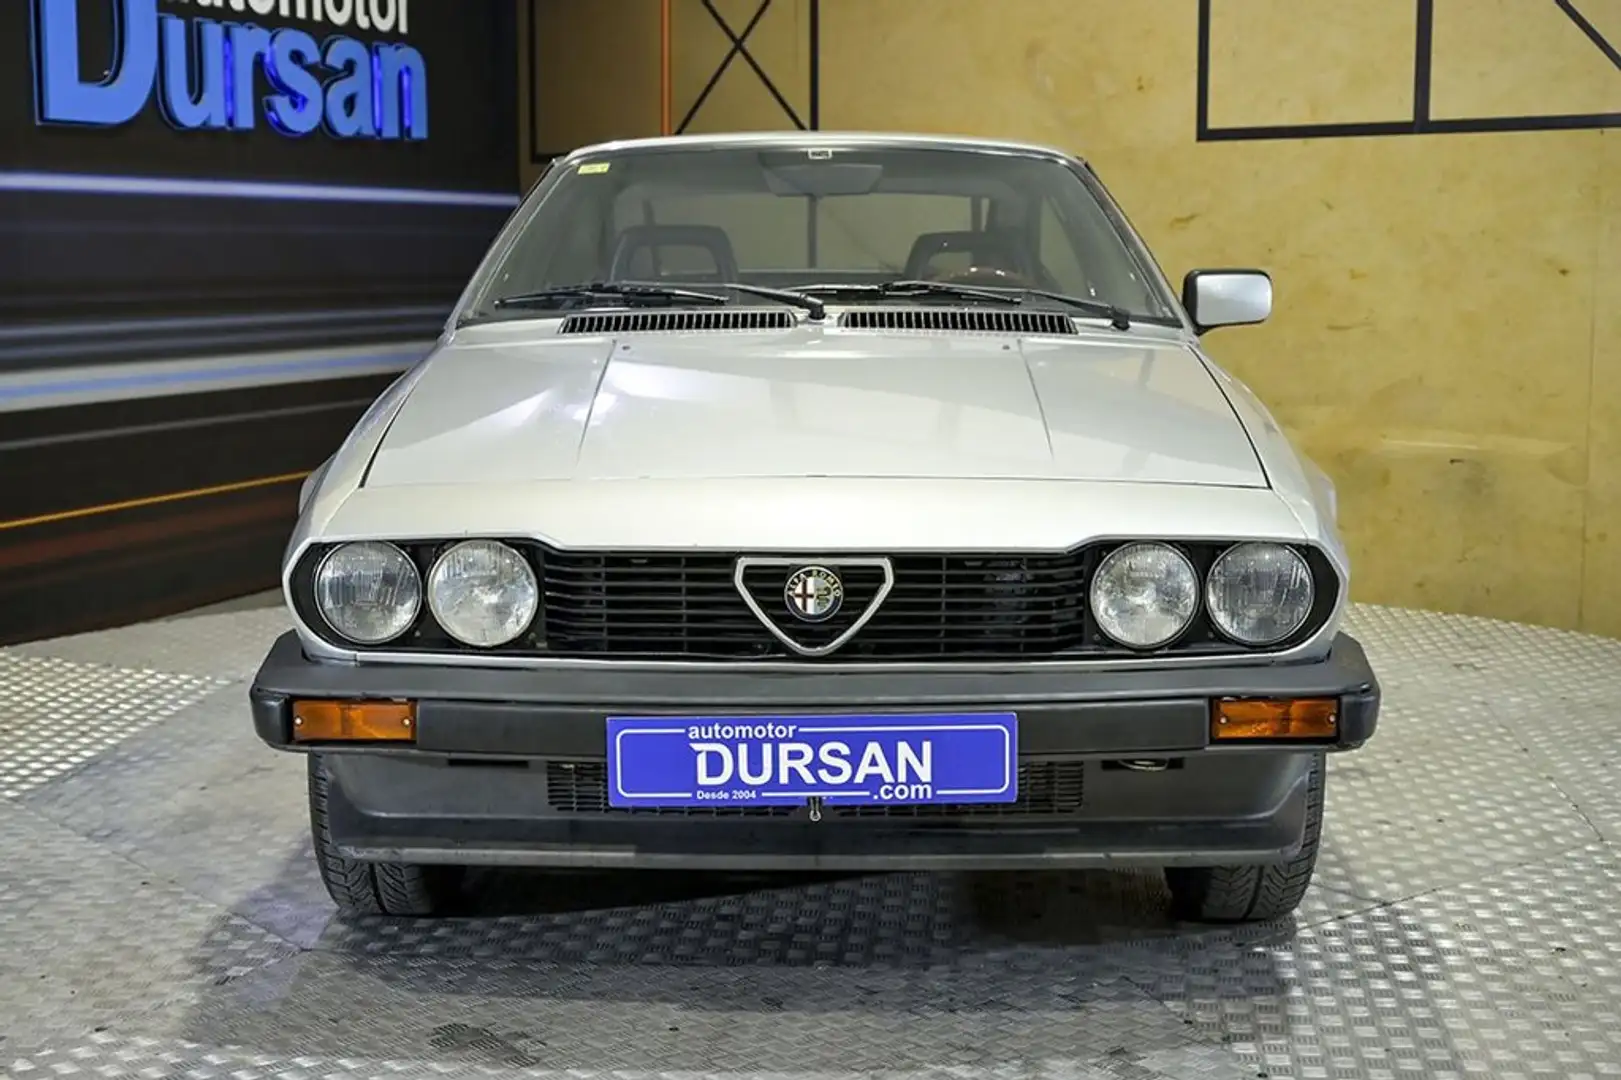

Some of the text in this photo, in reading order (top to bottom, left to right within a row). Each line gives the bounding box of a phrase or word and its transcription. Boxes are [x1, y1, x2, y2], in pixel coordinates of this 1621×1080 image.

[34, 0, 429, 141] Dursan
[687, 722, 797, 739] automotor
[689, 741, 932, 785] DURSAN
[696, 789, 756, 800] Desde 2004
[873, 783, 932, 800] .com
